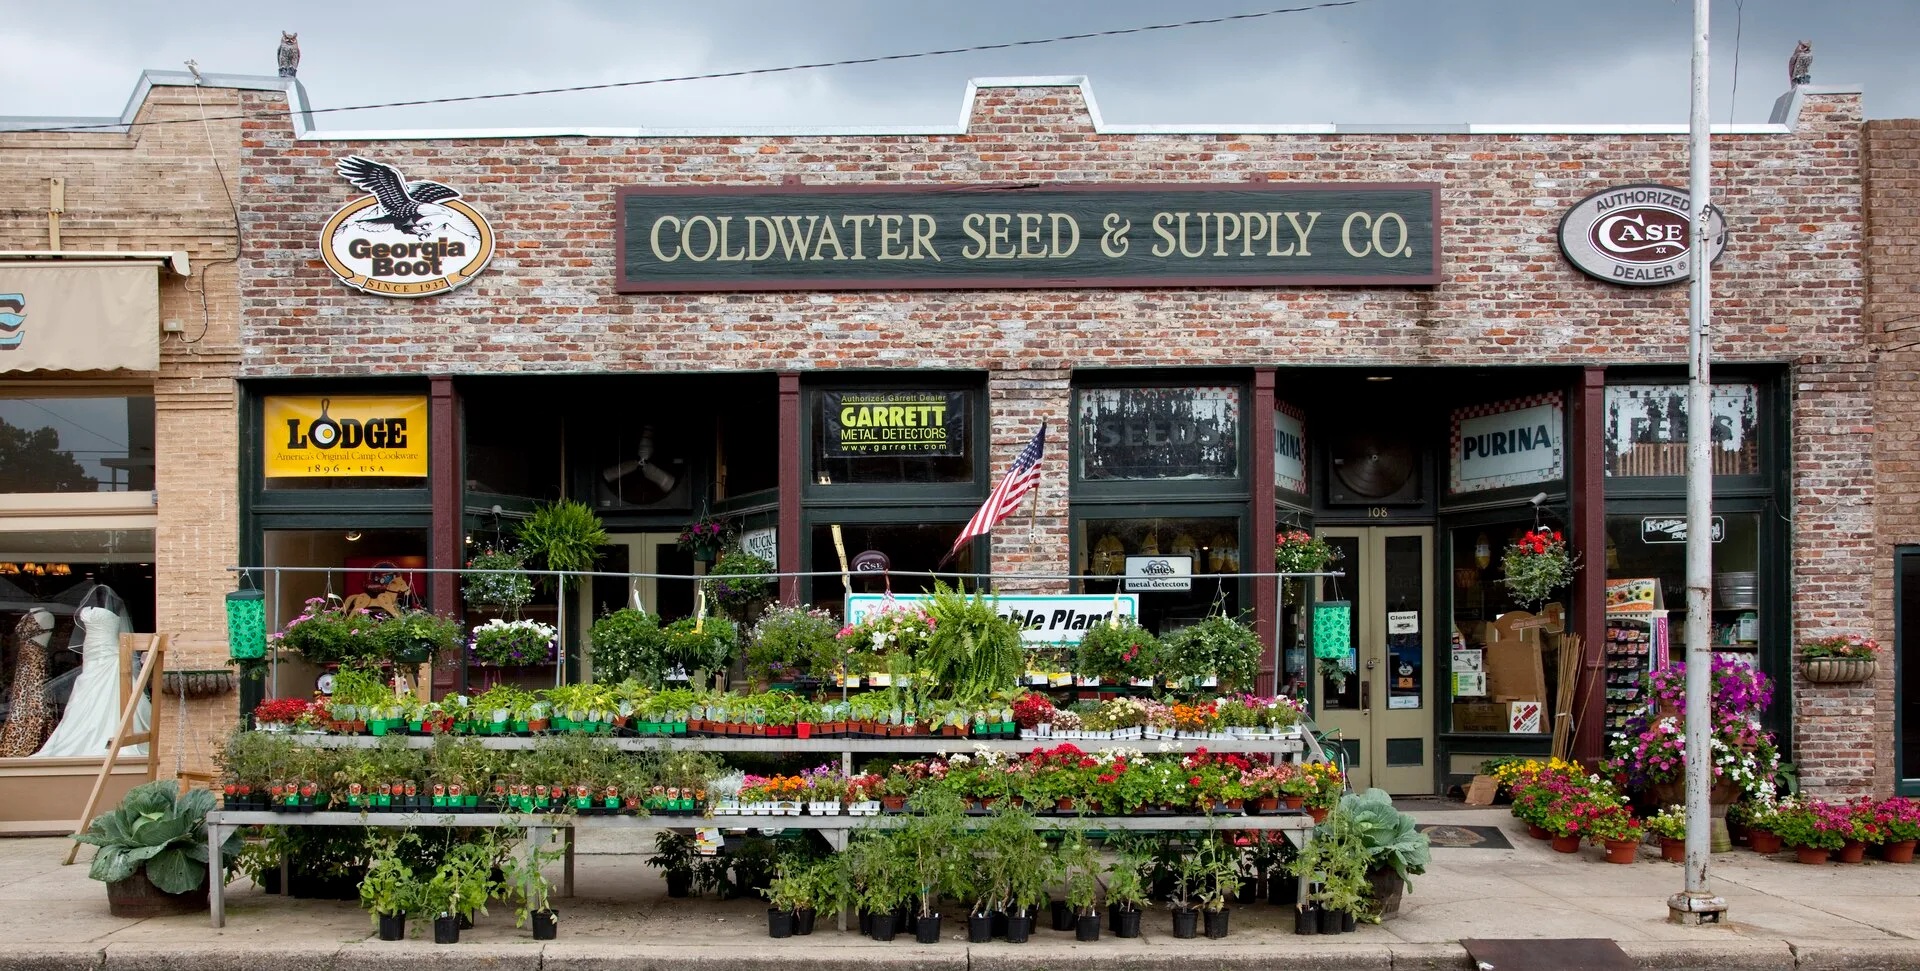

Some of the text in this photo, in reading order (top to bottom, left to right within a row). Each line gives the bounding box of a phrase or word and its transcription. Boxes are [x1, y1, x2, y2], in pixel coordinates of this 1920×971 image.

[1597, 190, 1690, 213] AUTHORIZED
[650, 211, 1412, 262] COLDWATER SEED & SUPPLY CO.
[348, 237, 466, 261] Georgia
[372, 257, 443, 277] Boot
[1613, 264, 1676, 281] DEALER
[367, 280, 445, 293] SINCE 1937
[841, 394, 946, 403] Authorized Garrett Dealer
[840, 405, 946, 427] GARRETT
[287, 415, 407, 450] LODGE
[841, 427, 946, 440] METAL DETECTORS
[1098, 418, 1221, 448] SEEDS
[842, 444, 947, 452] www.garrett.com
[1274, 428, 1301, 461] URINA
[1463, 424, 1552, 461] PURINA
[275, 451, 418, 463] America's Original Camp Cookware
[307, 464, 385, 473] 1896 USA
[1367, 506, 1388, 518] 108
[1128, 580, 1189, 588] metal detectors
